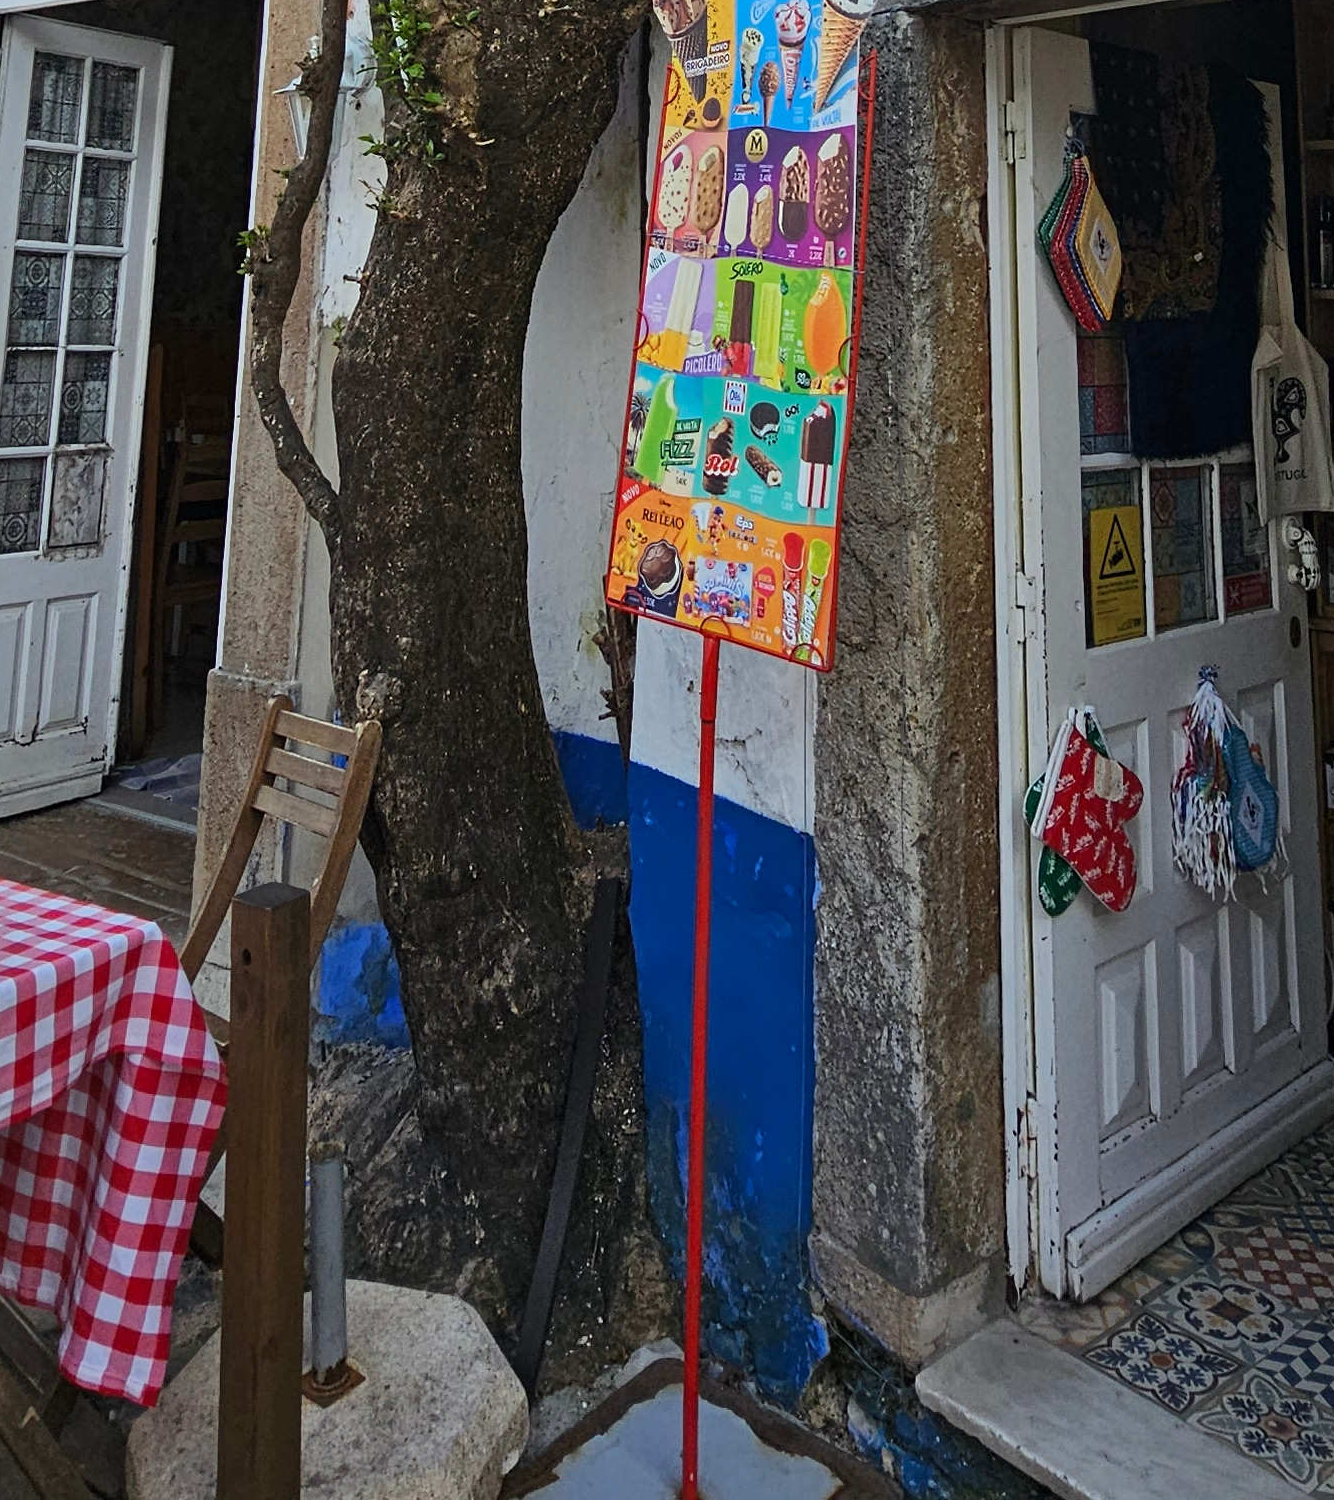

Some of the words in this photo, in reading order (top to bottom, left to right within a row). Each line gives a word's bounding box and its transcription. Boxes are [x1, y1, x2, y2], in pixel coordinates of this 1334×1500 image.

[685, 54, 730, 72] BRIGADEIRO
[663, 129, 684, 151] NOVOS
[649, 252, 667, 273] NOVO
[729, 261, 764, 280] SOLERO
[684, 353, 722, 373] PICOLERO
[660, 439, 695, 460] FIZZ
[705, 454, 737, 474] Rol
[621, 484, 641, 504] NOVO
[783, 590, 797, 646] Calippo
